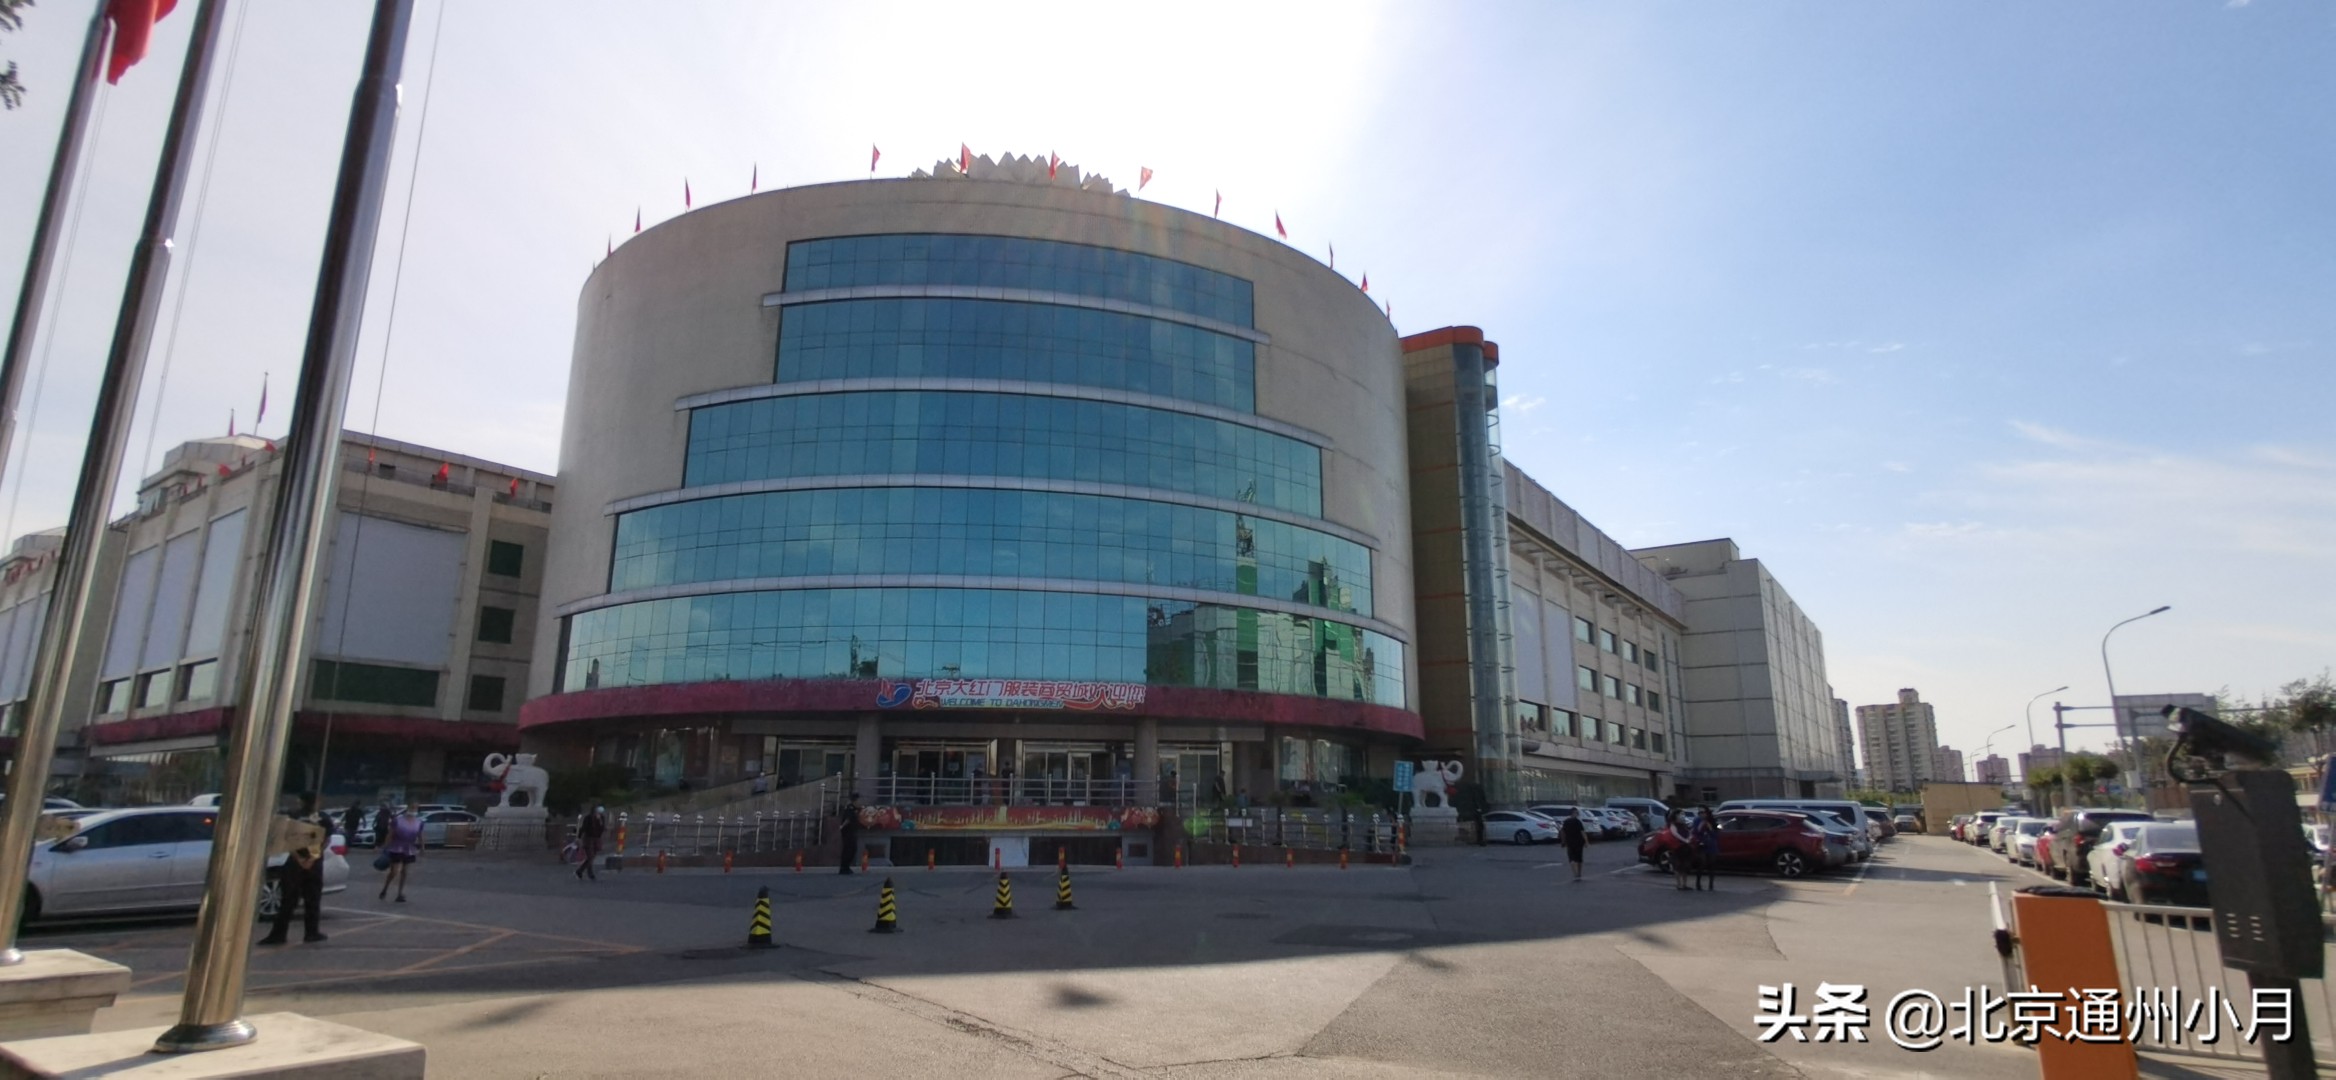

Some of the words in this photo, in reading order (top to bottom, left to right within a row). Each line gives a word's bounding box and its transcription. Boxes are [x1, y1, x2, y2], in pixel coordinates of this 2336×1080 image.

[915, 680, 1146, 704] 北京大红门服装商贸城欢迎您
[942, 698, 985, 706] WELCOME
